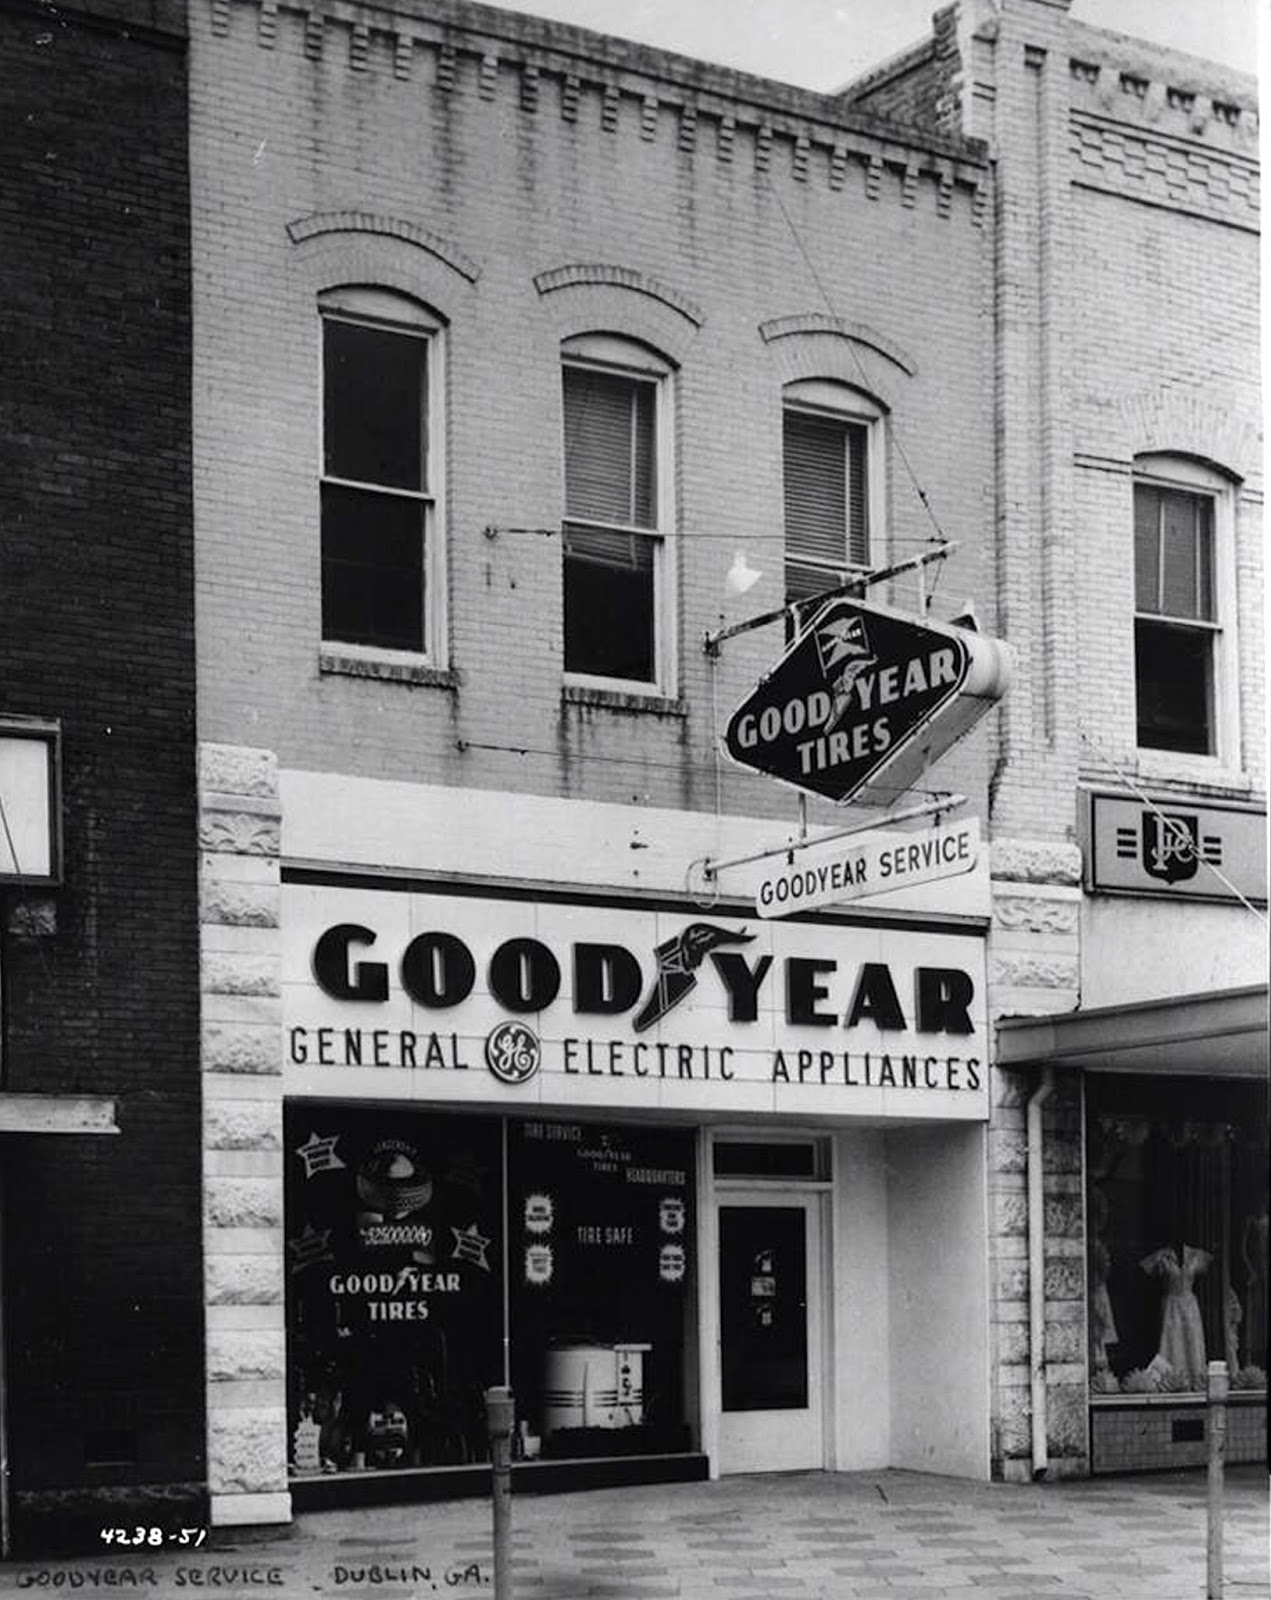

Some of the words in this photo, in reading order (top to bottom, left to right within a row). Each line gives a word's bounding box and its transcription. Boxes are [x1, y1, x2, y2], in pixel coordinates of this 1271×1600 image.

[797, 717, 891, 775] TIRES
[760, 859, 867, 906] GOODYEAR
[880, 832, 970, 877] SERVICE
[291, 1026, 468, 1070] GENERAL
[564, 1038, 735, 1081] ELECTRIC
[772, 1049, 981, 1091] APPLIANCES
[367, 1301, 429, 1321] TIRES
